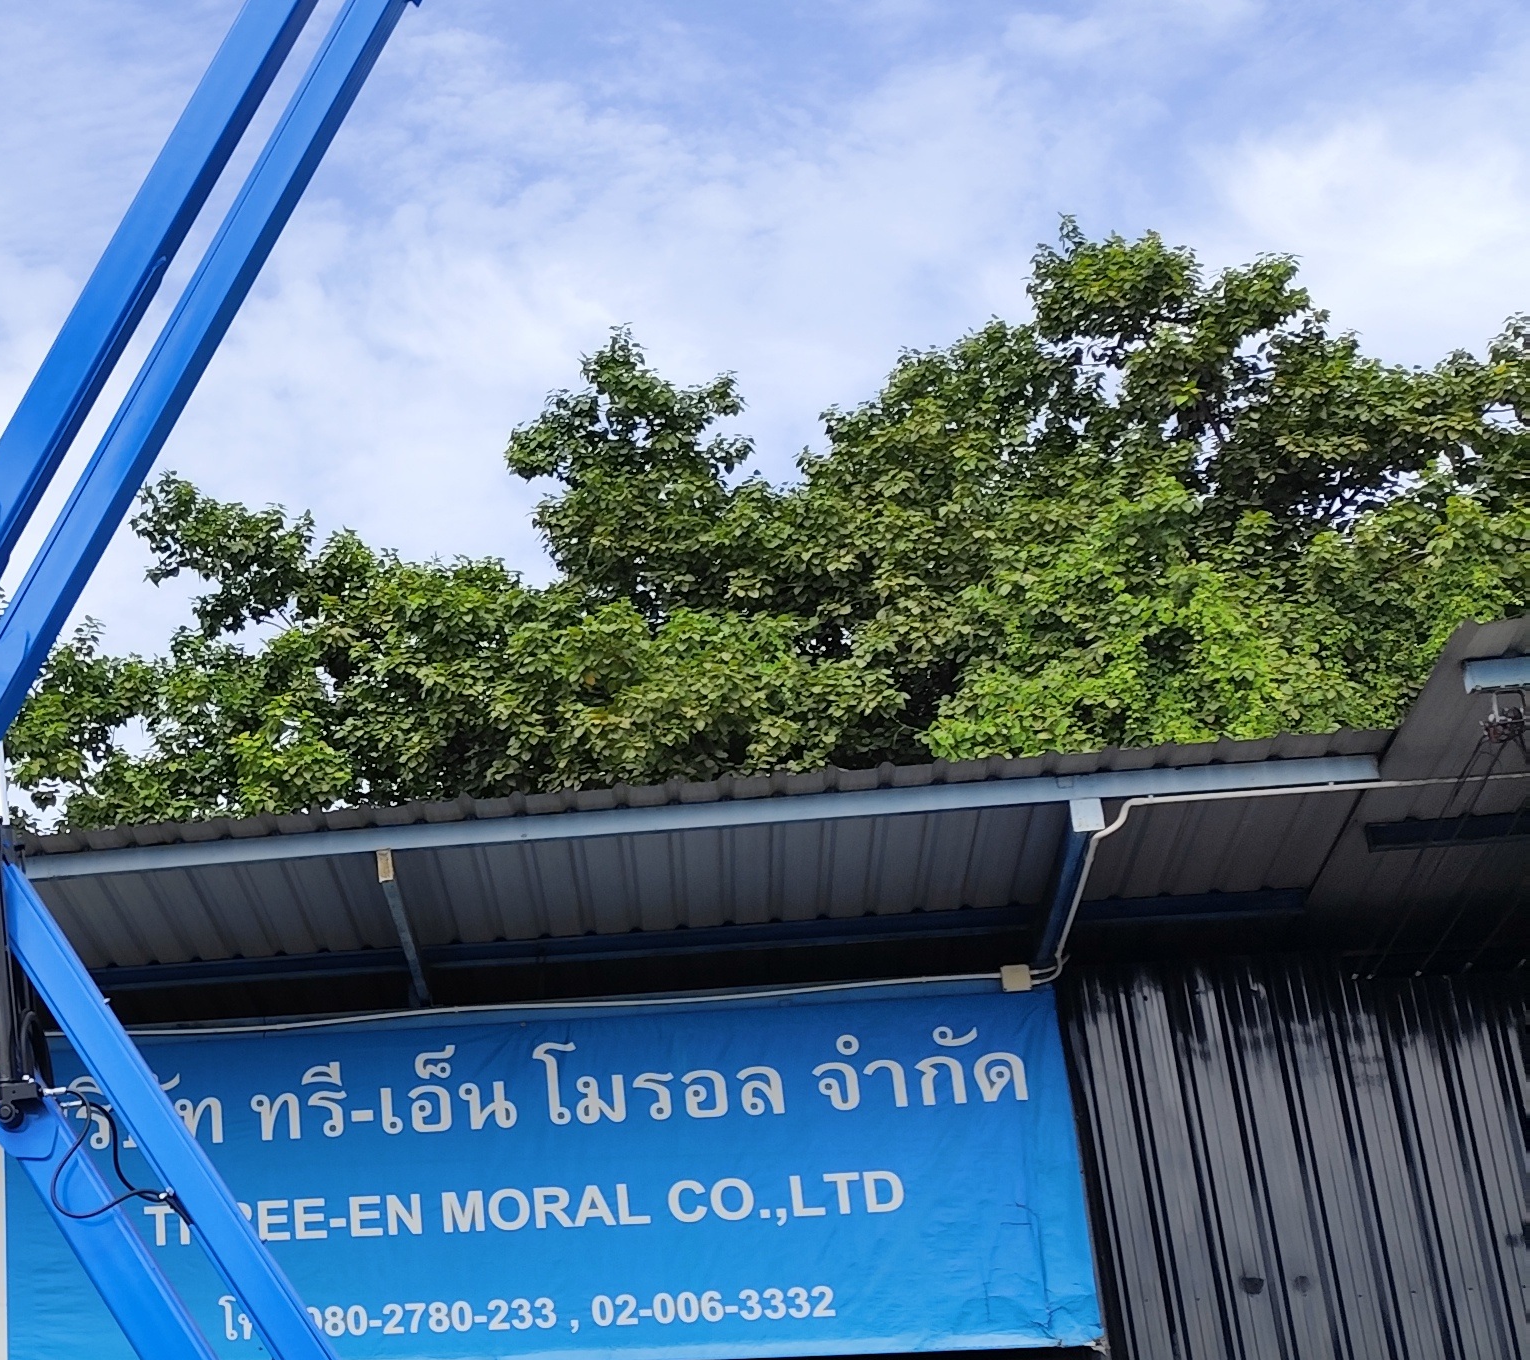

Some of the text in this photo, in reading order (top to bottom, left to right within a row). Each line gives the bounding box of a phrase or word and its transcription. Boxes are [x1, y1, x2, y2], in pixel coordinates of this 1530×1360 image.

[250, 1044, 518, 1142] ทรี-เอ็น
[532, 1041, 786, 1126] โมรอล
[811, 1026, 1029, 1111] จำกัด
[441, 1183, 651, 1234] MORAL
[667, 1170, 905, 1227] CO.,LTD
[591, 1285, 837, 1327] 02-006-3332
